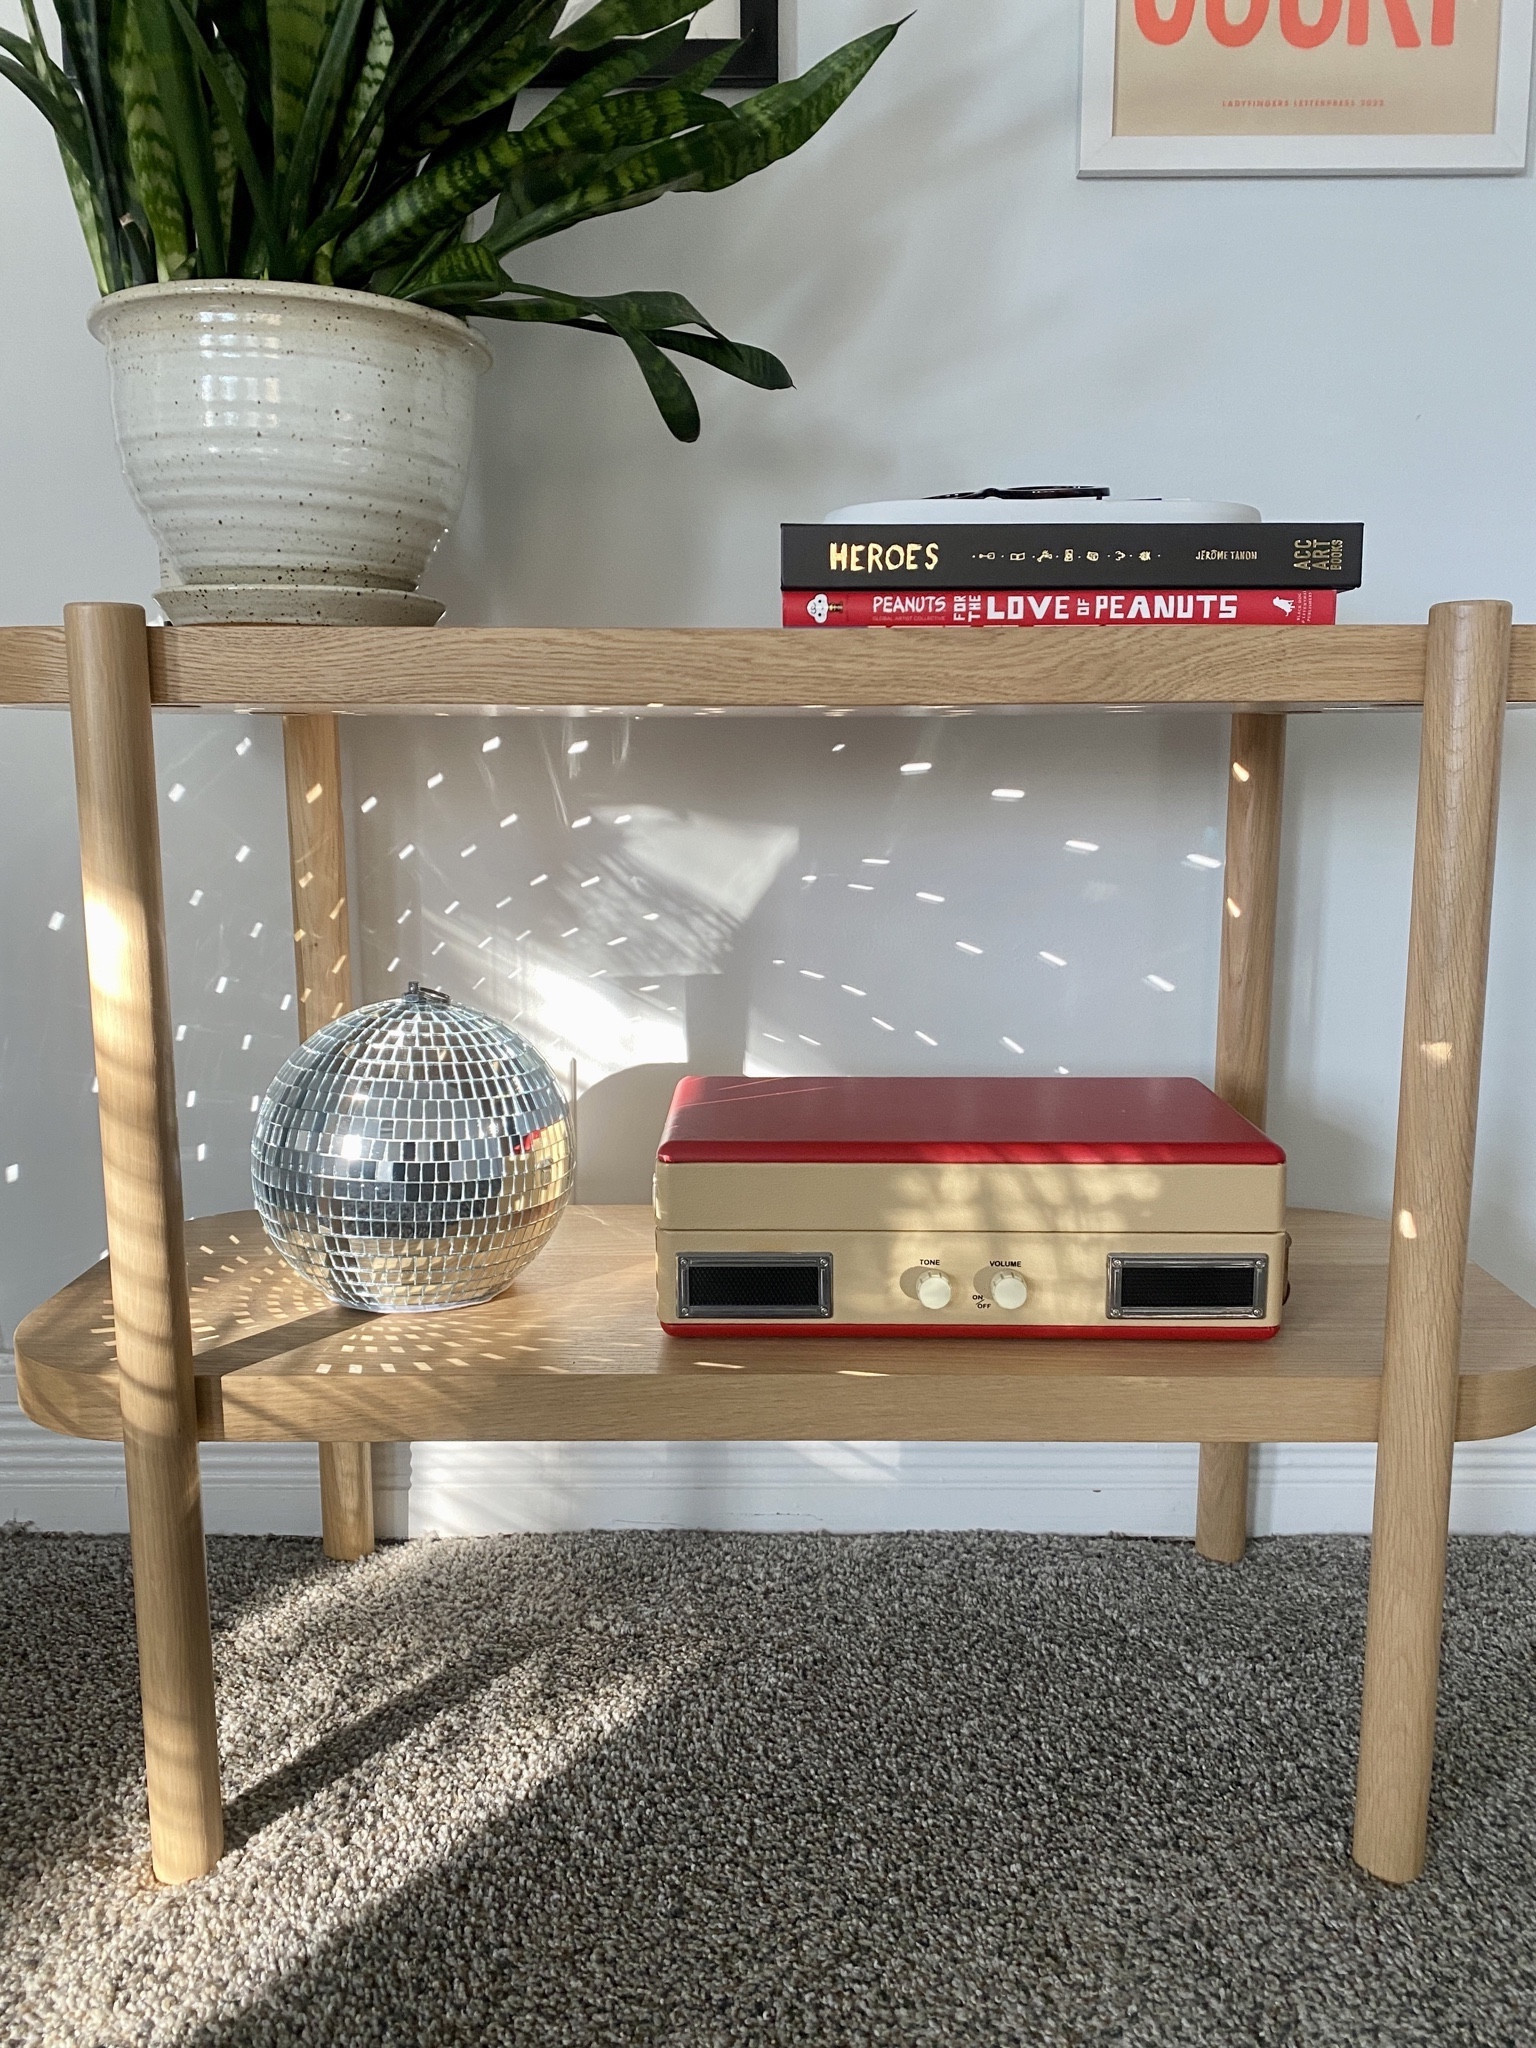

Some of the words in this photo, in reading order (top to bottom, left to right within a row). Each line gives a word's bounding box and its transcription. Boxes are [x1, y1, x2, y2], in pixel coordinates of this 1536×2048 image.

[1222, 99, 1289, 108] LADYFINGERS
[1293, 99, 1355, 107] LETTERPRESS
[829, 542, 940, 574] HEROES
[1230, 550, 1258, 561] TANON
[1293, 539, 1312, 571] ACC
[1312, 539, 1330, 571] ART
[1330, 539, 1343, 571] BOOKS
[873, 595, 947, 613] PEANUTS
[953, 595, 967, 621] FOR
[968, 594, 982, 623] THE
[986, 595, 1070, 620] LOVE
[1076, 597, 1090, 616] OF
[1094, 594, 1238, 619] PEANUTS
[989, 1260, 1022, 1268] VOLUME
